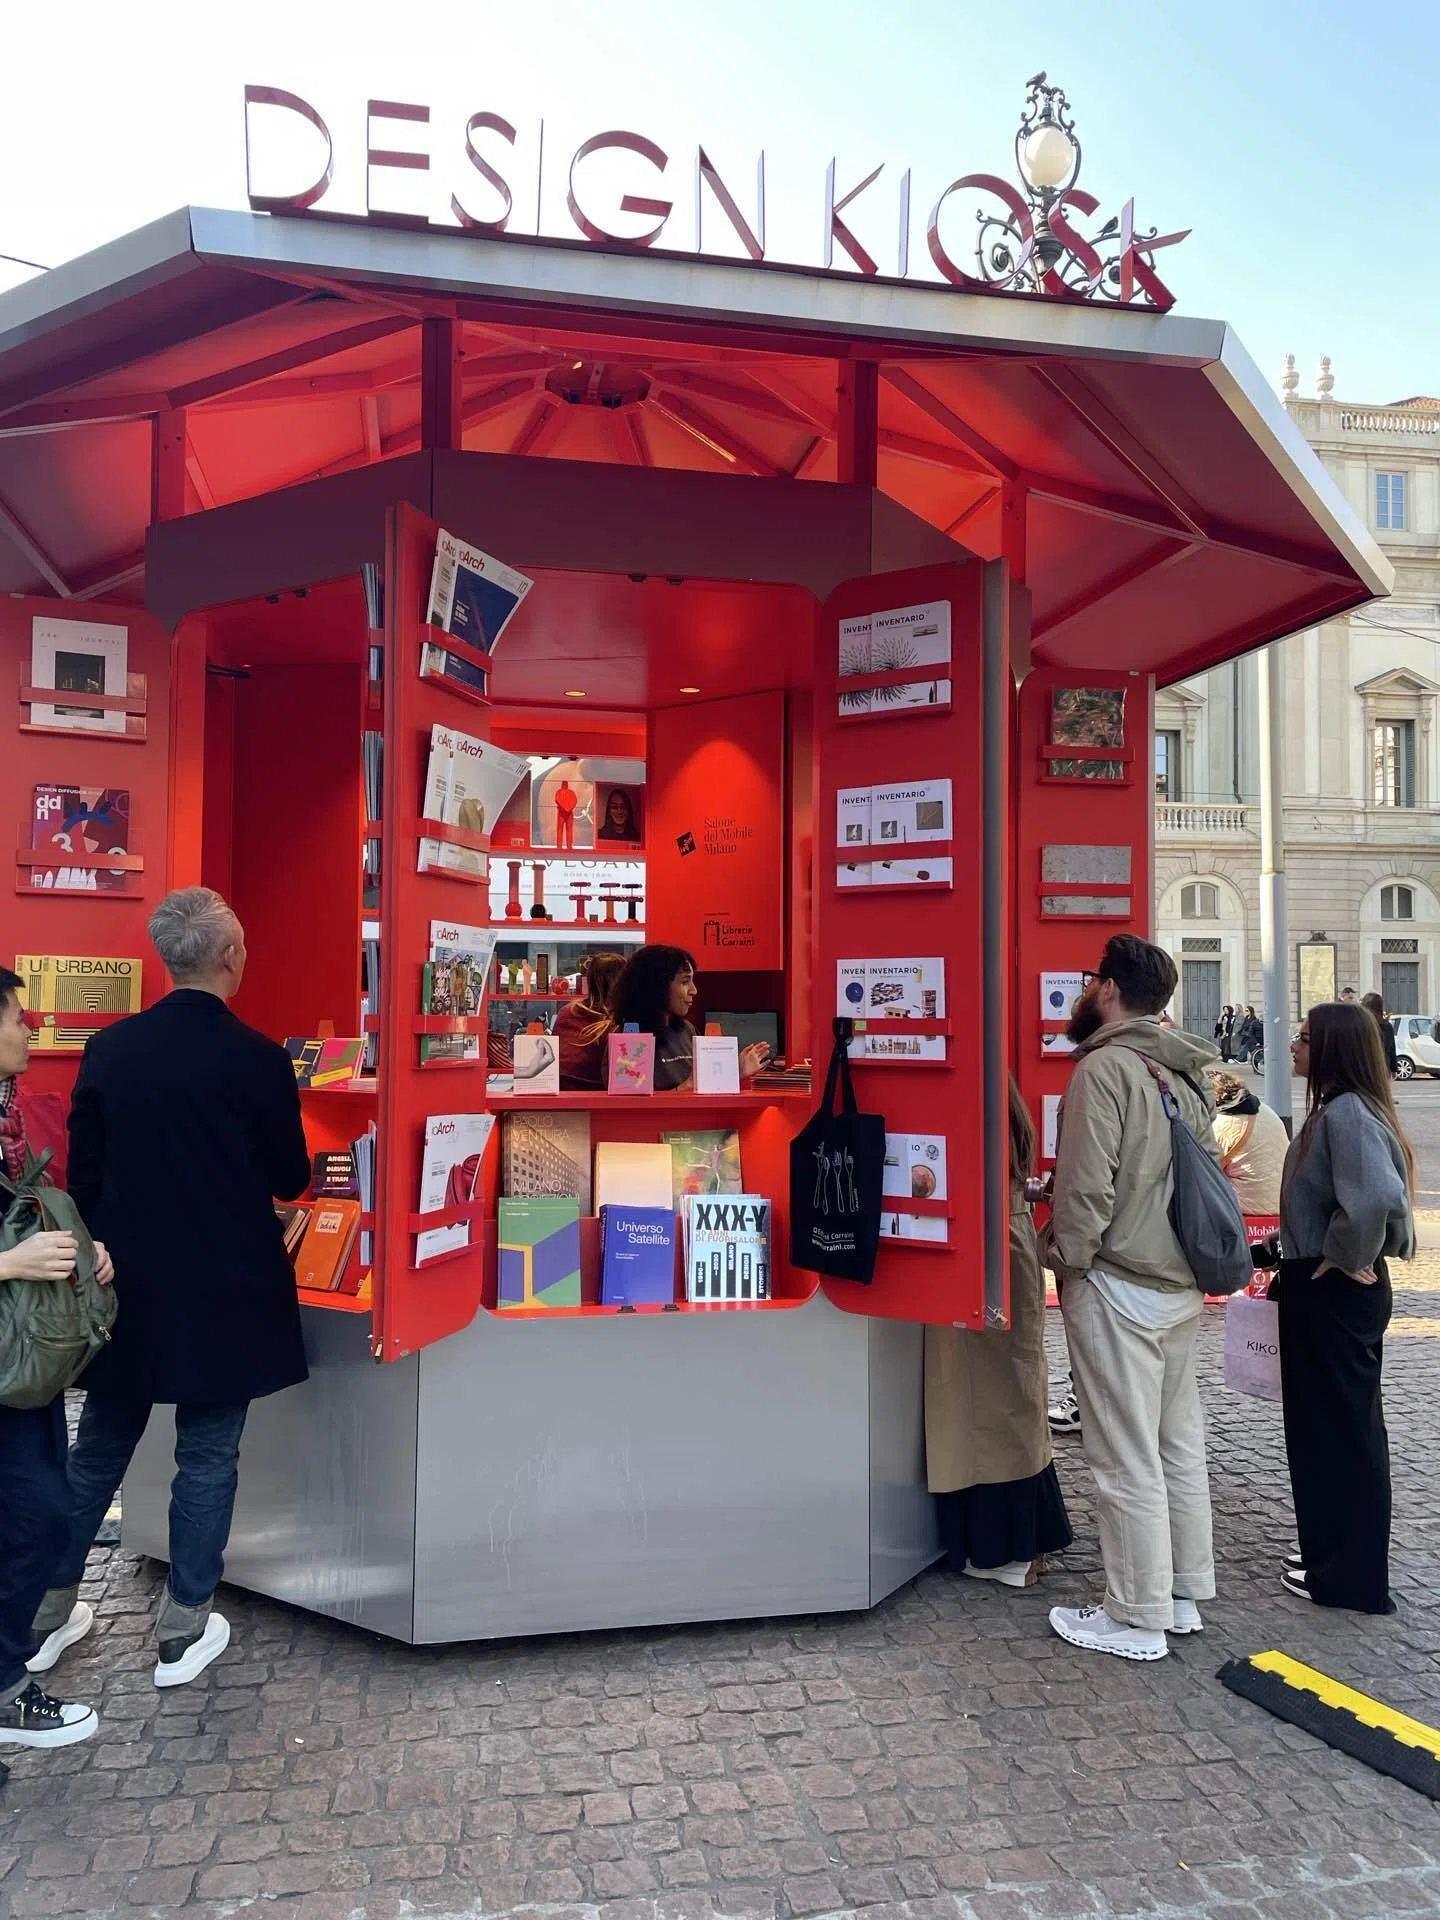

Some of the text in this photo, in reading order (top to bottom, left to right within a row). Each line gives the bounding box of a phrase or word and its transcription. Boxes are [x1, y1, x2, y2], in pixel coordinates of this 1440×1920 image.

[244, 84, 1193, 309] DESIGN KIOSK
[876, 613, 925, 628] INVENTARIO
[842, 796, 872, 806] INVENT
[876, 790, 926, 801] INVENTARIO
[703, 817, 737, 829] Salone
[703, 826, 753, 842] del Mobile
[703, 843, 737, 855] Milano
[721, 936, 755, 947] Corraini
[56, 959, 132, 975] URBANO
[869, 967, 919, 975] INVENTARIO
[513, 1115, 553, 1128] PAOLO
[511, 1129, 569, 1141] VENTURA
[513, 1179, 562, 1192] MILANO
[696, 1203, 768, 1232] XXX-Y
[616, 1220, 664, 1234] Universo
[628, 1232, 670, 1245] Satellite
[1246, 1340, 1278, 1355] KIKO
